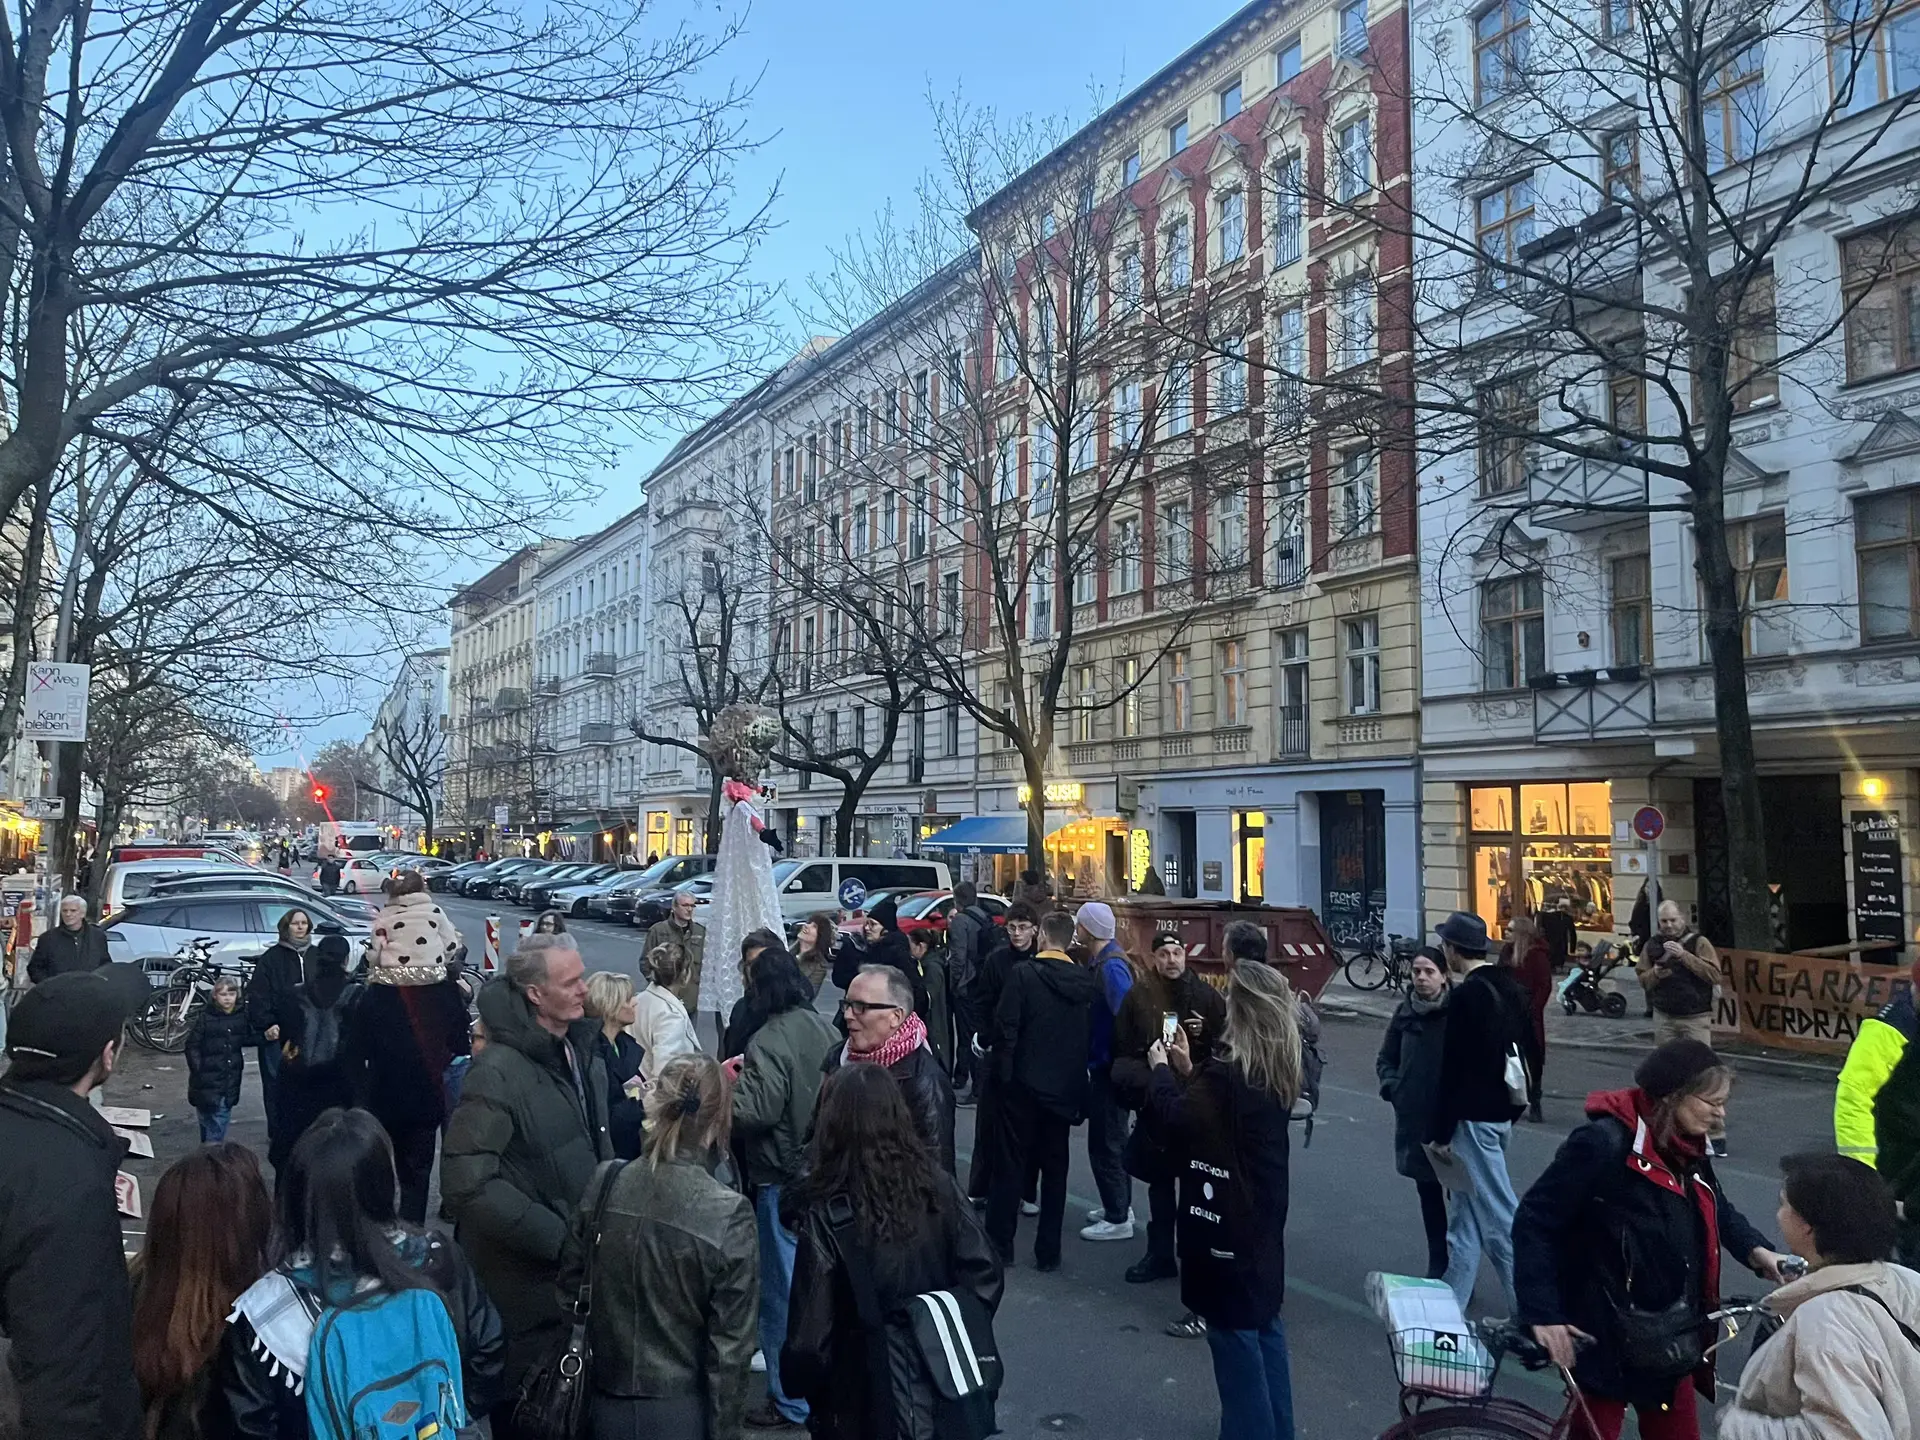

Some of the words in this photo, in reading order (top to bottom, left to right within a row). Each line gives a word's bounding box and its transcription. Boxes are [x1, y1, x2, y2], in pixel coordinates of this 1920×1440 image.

[30, 665, 60, 676] Kann
[54, 676, 79, 687] weg
[25, 720, 69, 730] bleiben
